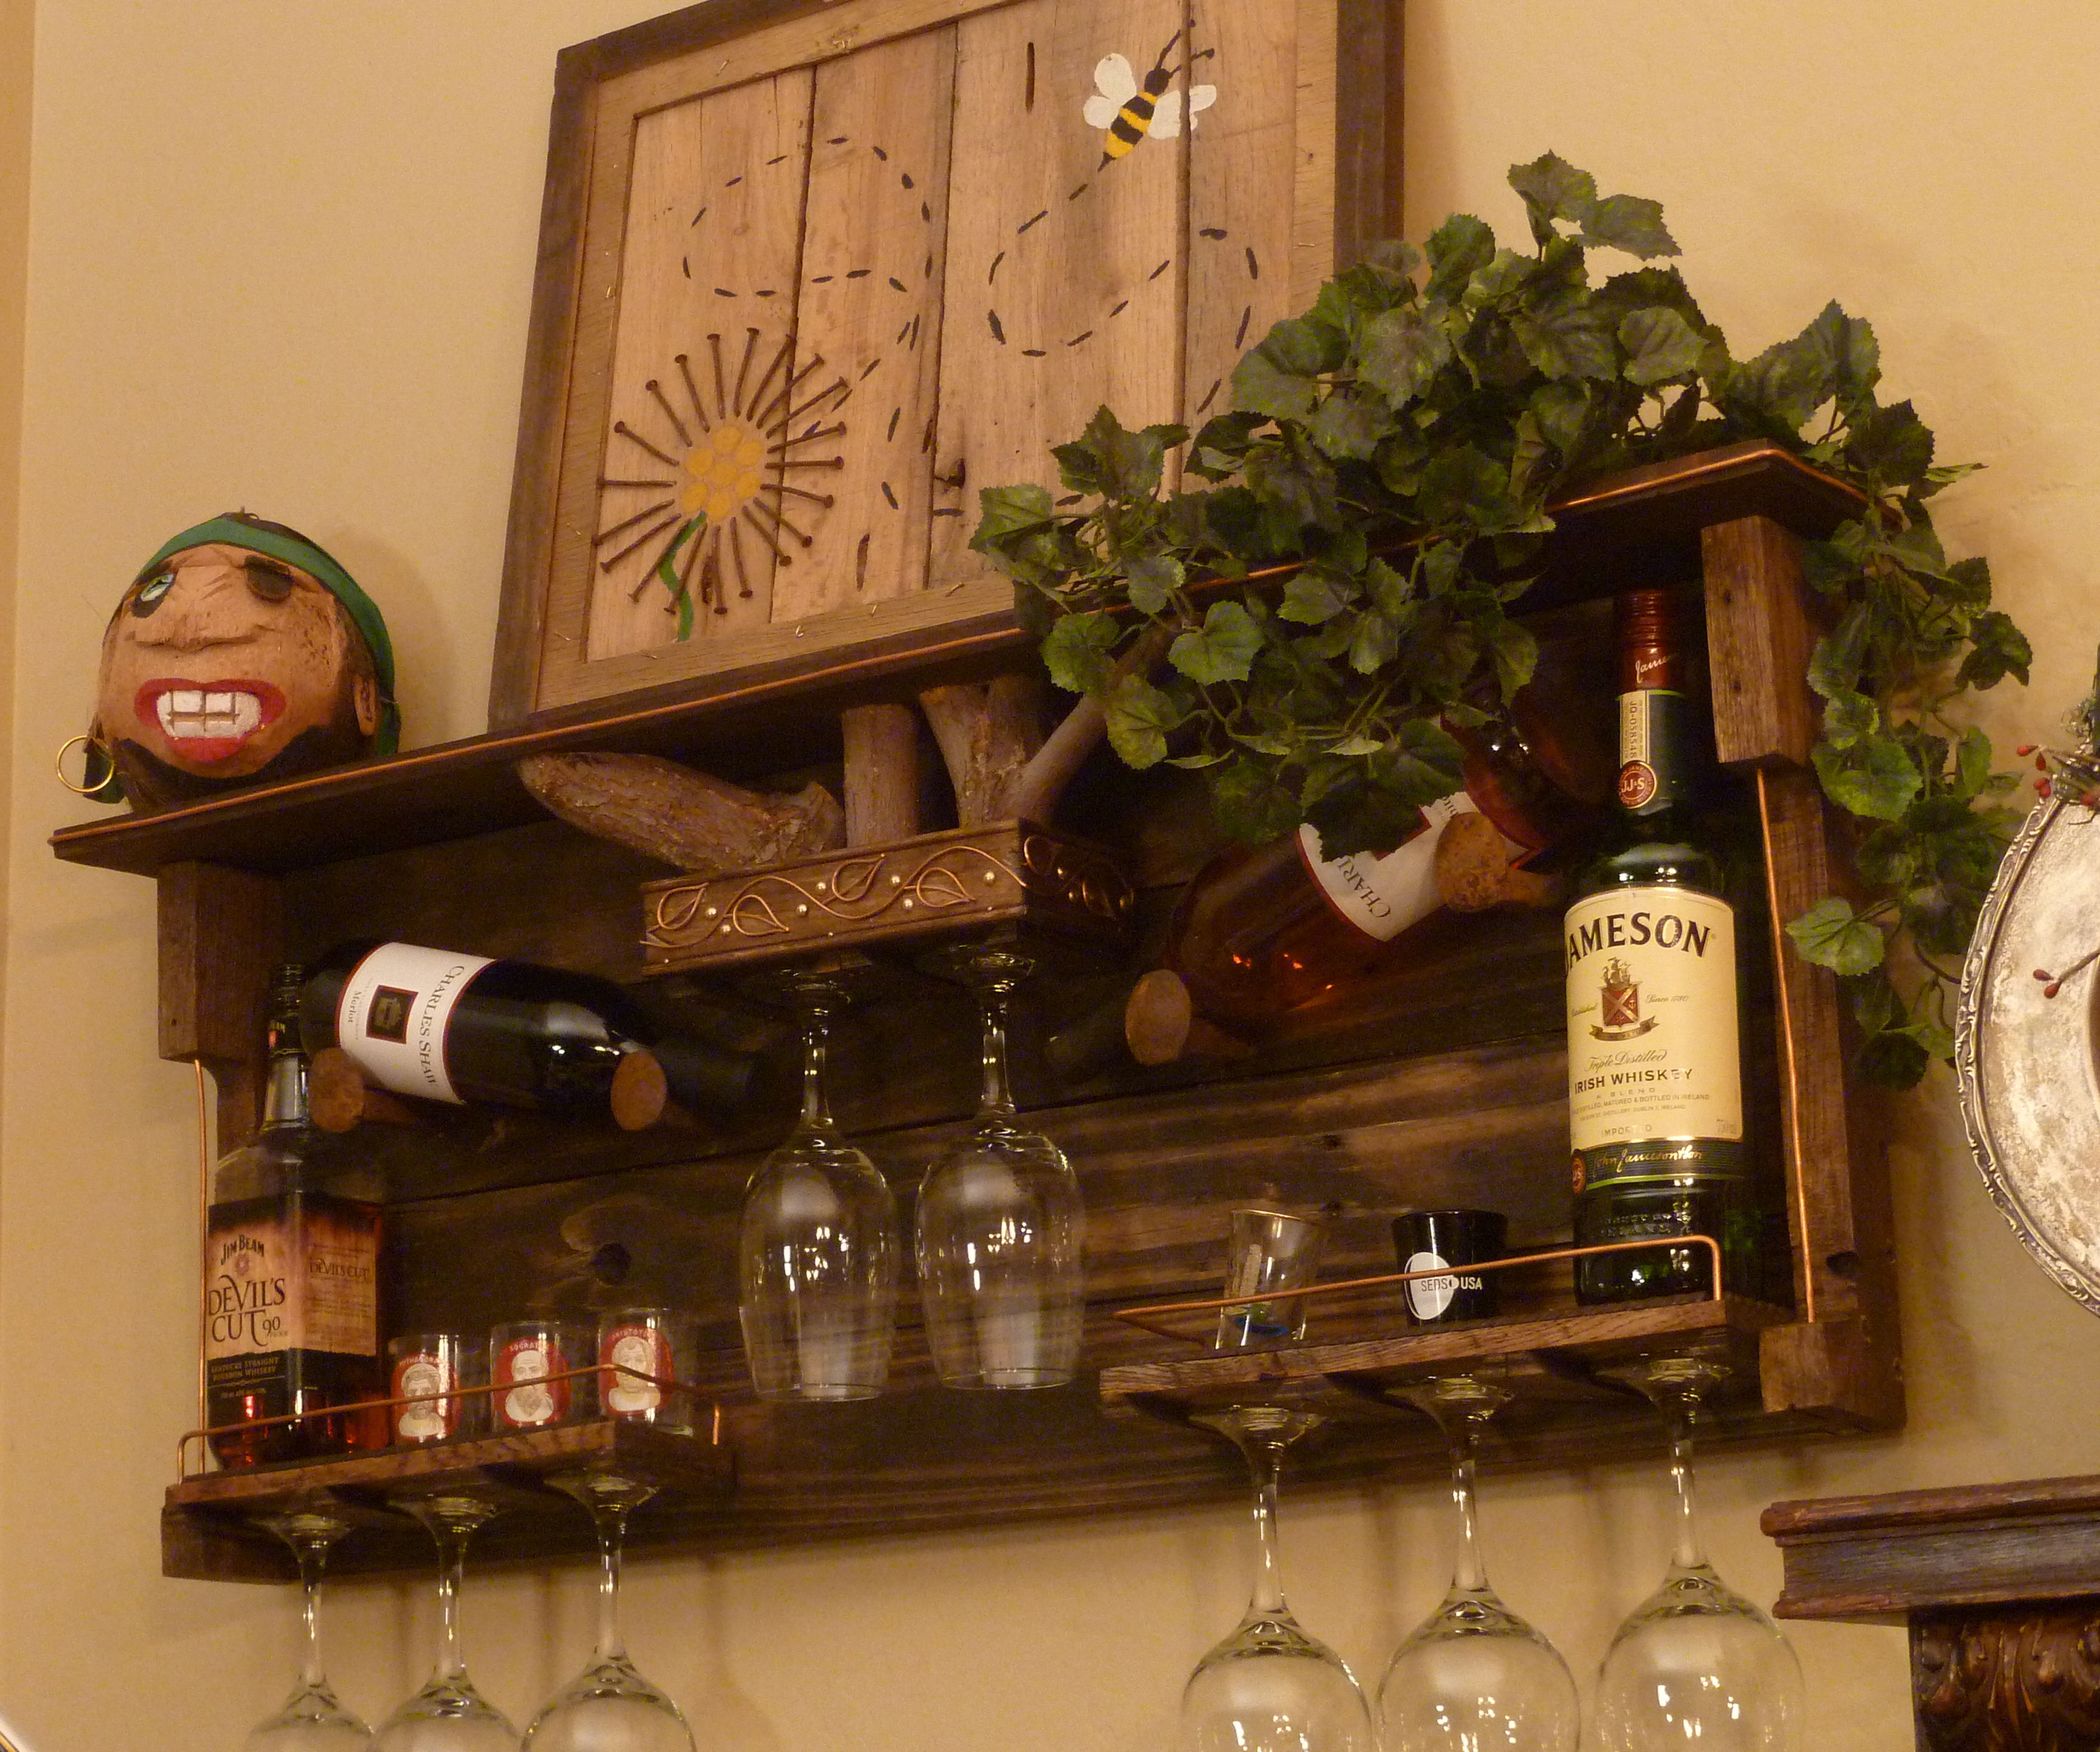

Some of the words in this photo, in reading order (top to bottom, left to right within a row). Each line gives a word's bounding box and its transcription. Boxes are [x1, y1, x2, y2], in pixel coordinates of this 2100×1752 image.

[420, 965, 465, 1037] CHARLES
[1612, 1049, 1668, 1068] Distilled
[1574, 1075, 1605, 1094] IRISH
[1611, 1068, 1693, 1085] WHISKEY
[1610, 1087, 1656, 1098] BLEND
[1639, 1094, 1671, 1103] BOTTLED
[1601, 1124, 1653, 1137] IMPORD
[221, 1240, 238, 1265] JIM
[239, 1234, 264, 1257] BEAM
[1460, 1277, 1483, 1290] USA
[208, 1274, 286, 1316] DEVIL'S
[212, 1309, 269, 1347] CUT
[262, 1316, 281, 1337] 90
